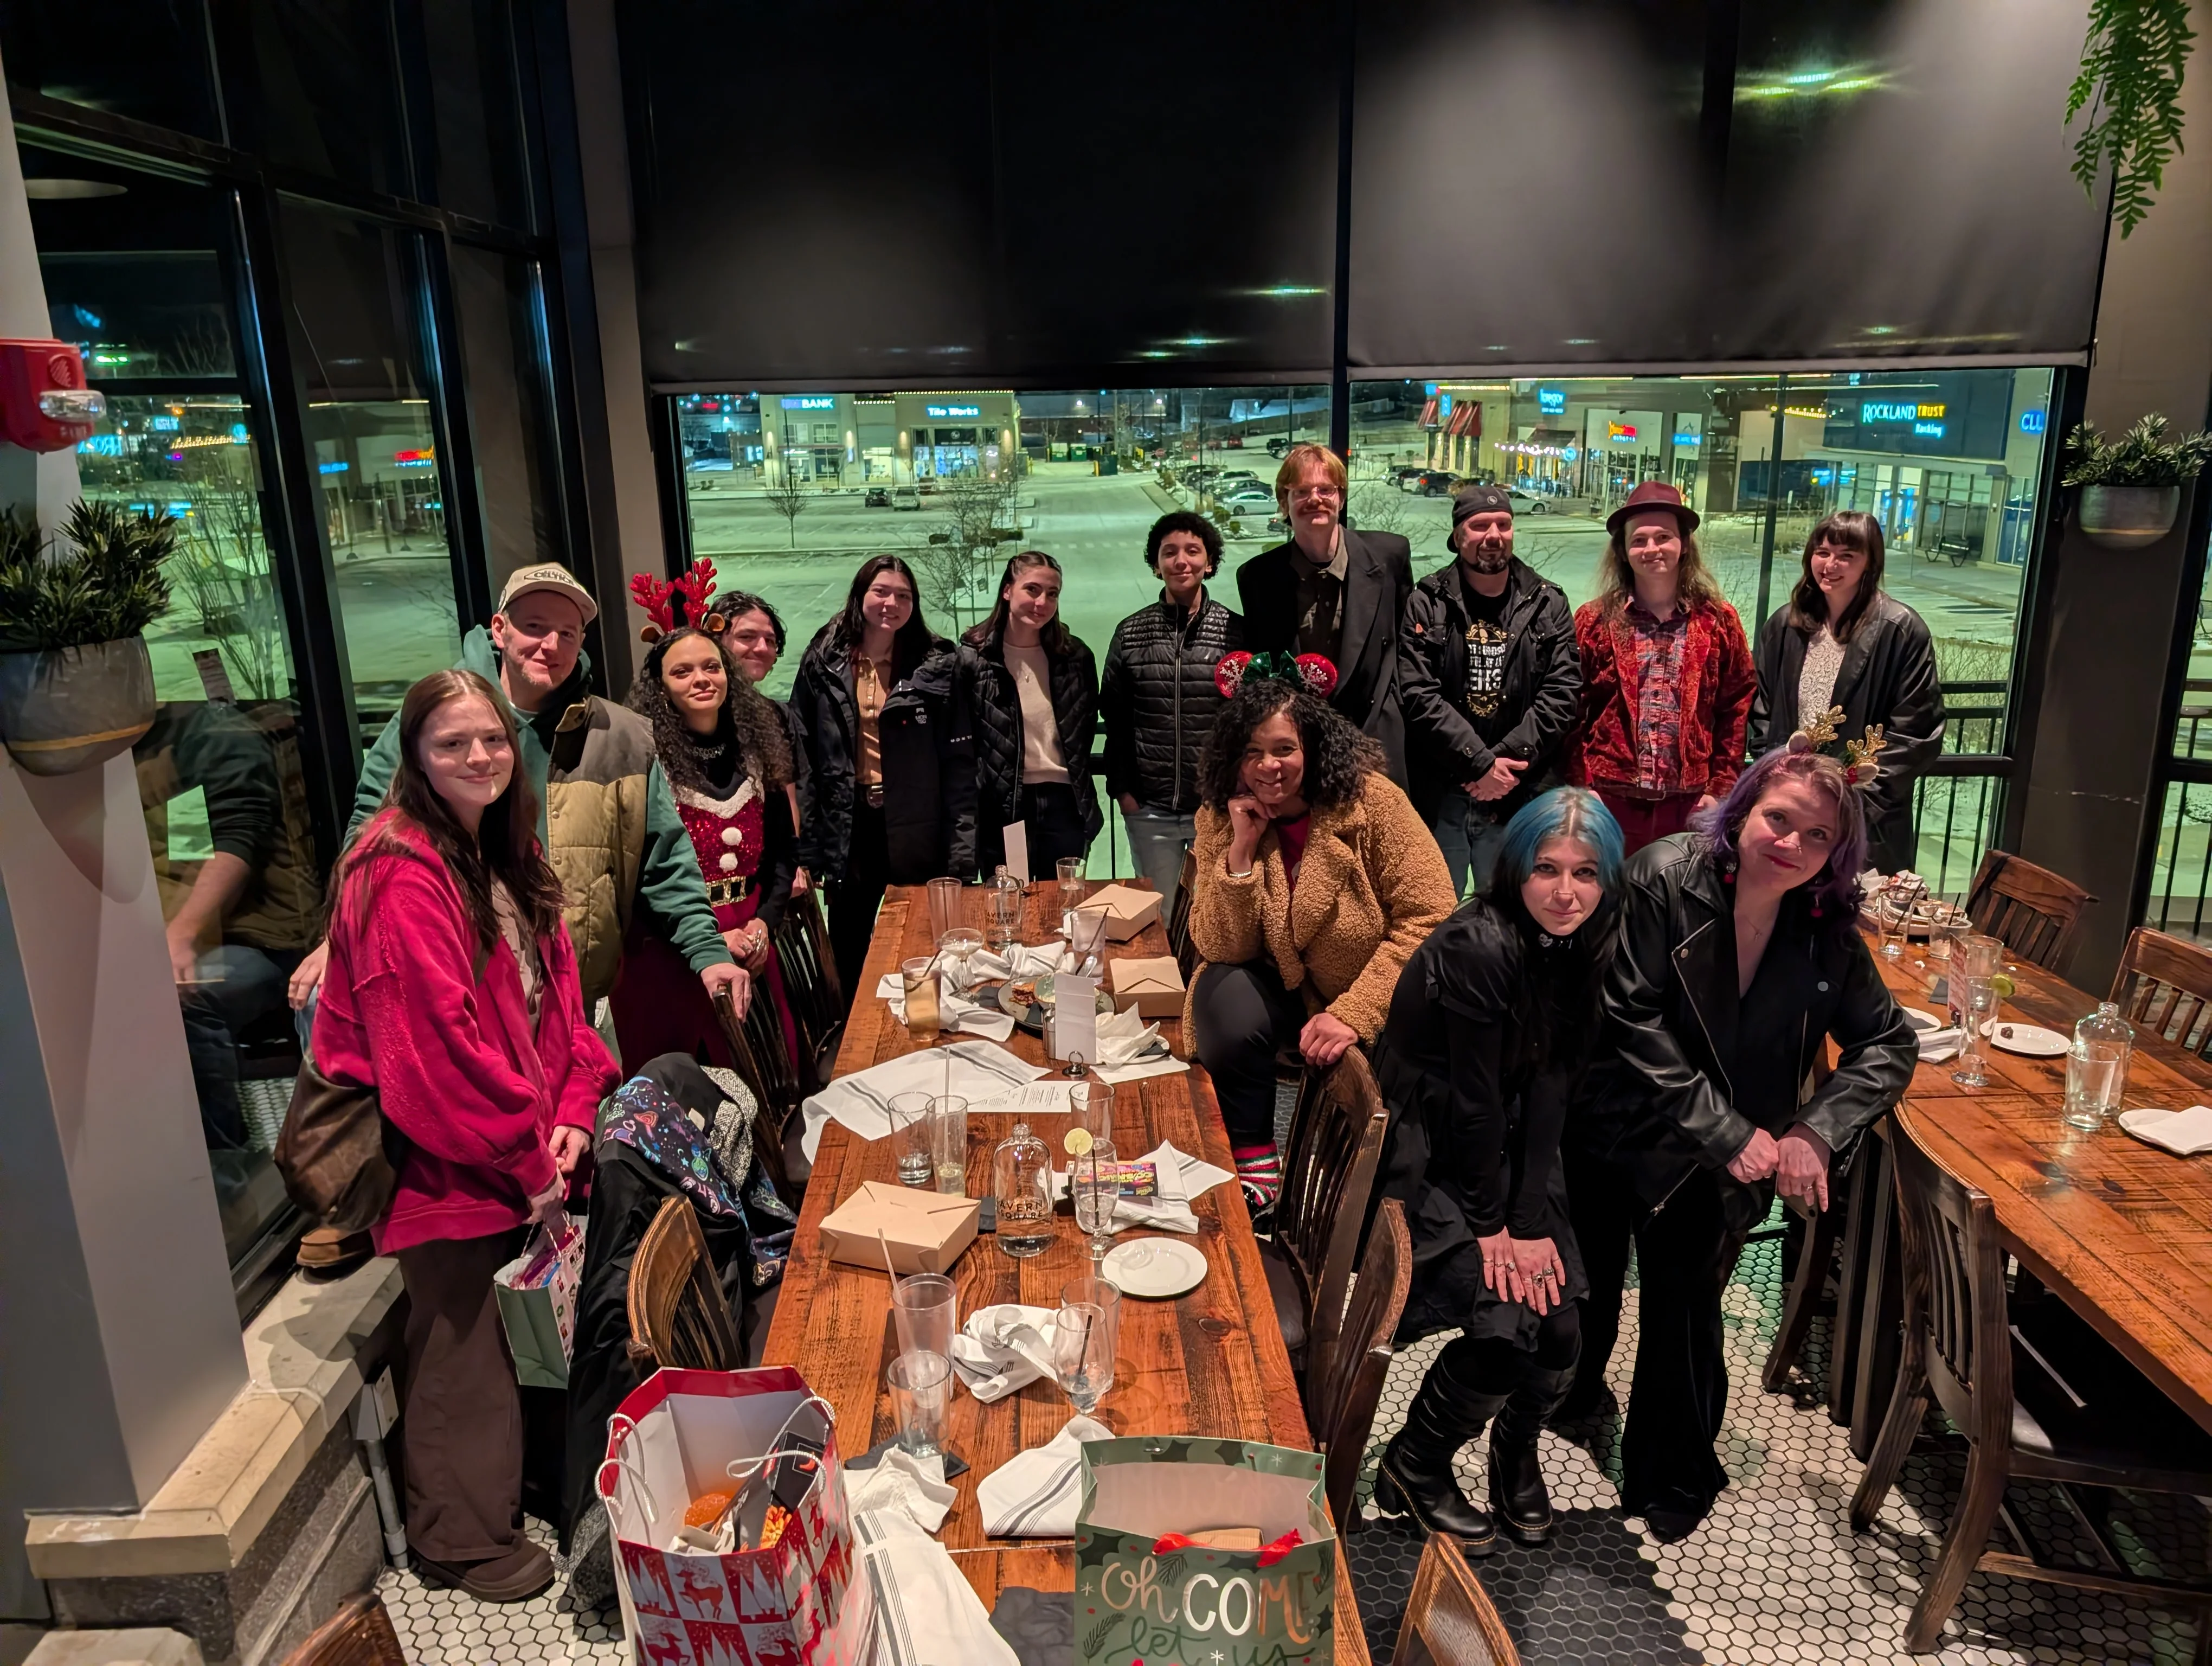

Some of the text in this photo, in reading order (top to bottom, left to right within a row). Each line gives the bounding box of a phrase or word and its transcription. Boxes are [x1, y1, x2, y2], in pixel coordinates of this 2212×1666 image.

[1862, 404, 1944, 423] ROCKLAND TRUST
[999, 1199, 1043, 1212] AVERN
[1000, 1209, 1043, 1220] SQUARE
